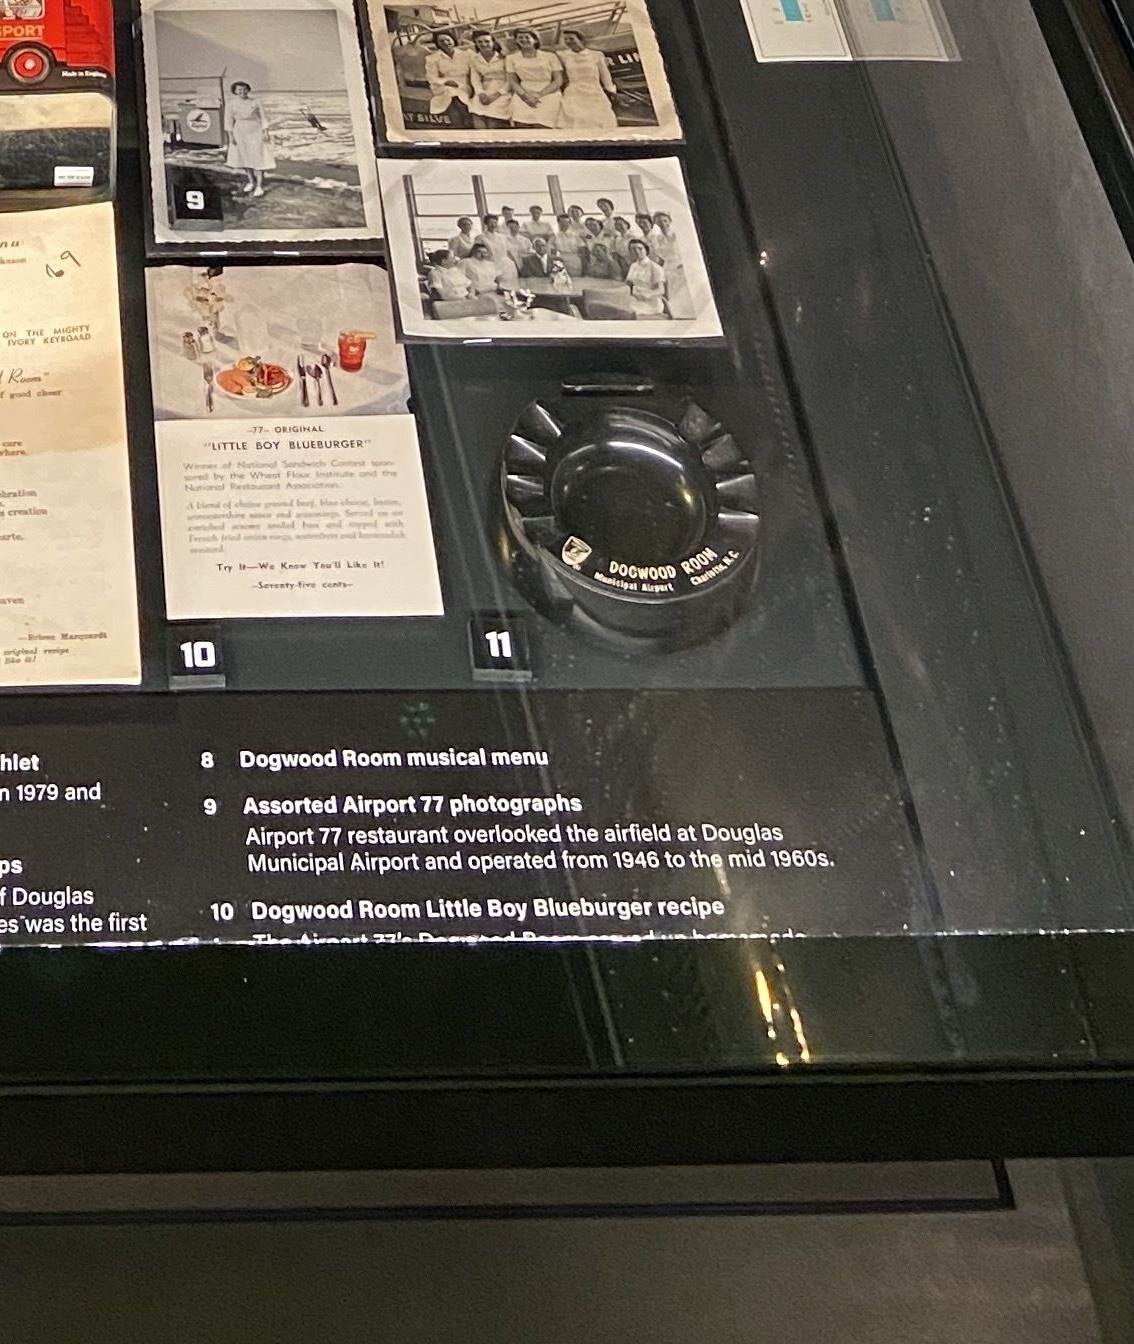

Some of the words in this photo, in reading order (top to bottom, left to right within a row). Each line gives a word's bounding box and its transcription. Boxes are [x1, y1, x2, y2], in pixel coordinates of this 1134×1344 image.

[186, 191, 204, 209] 9
[274, 425, 324, 434] ORIGINAL
[204, 441, 247, 451] "LITTLE
[255, 441, 280, 450] BOY
[288, 439, 370, 450] BLUEBURGER"
[680, 547, 718, 575] ROOM
[594, 572, 638, 591] Municipal
[641, 582, 674, 592] Airport
[180, 641, 216, 667] 10
[486, 631, 511, 657] 11
[201, 750, 214, 768] 8
[239, 748, 337, 771] Dogwood
[342, 749, 402, 767] Room
[406, 747, 486, 766] musical
[491, 751, 549, 766] menu
[204, 798, 216, 815] 9
[243, 795, 337, 814] Assorted
[342, 794, 417, 817] Airport
[419, 795, 444, 813] 77
[449, 793, 582, 817] photographs
[210, 902, 234, 921] 10
[251, 899, 353, 924] Dogwood
[358, 900, 421, 918] Room
[425, 898, 482, 918] Little
[486, 898, 527, 921] Boy
[533, 897, 652, 920] Blueburger
[657, 896, 729, 920] recipe
